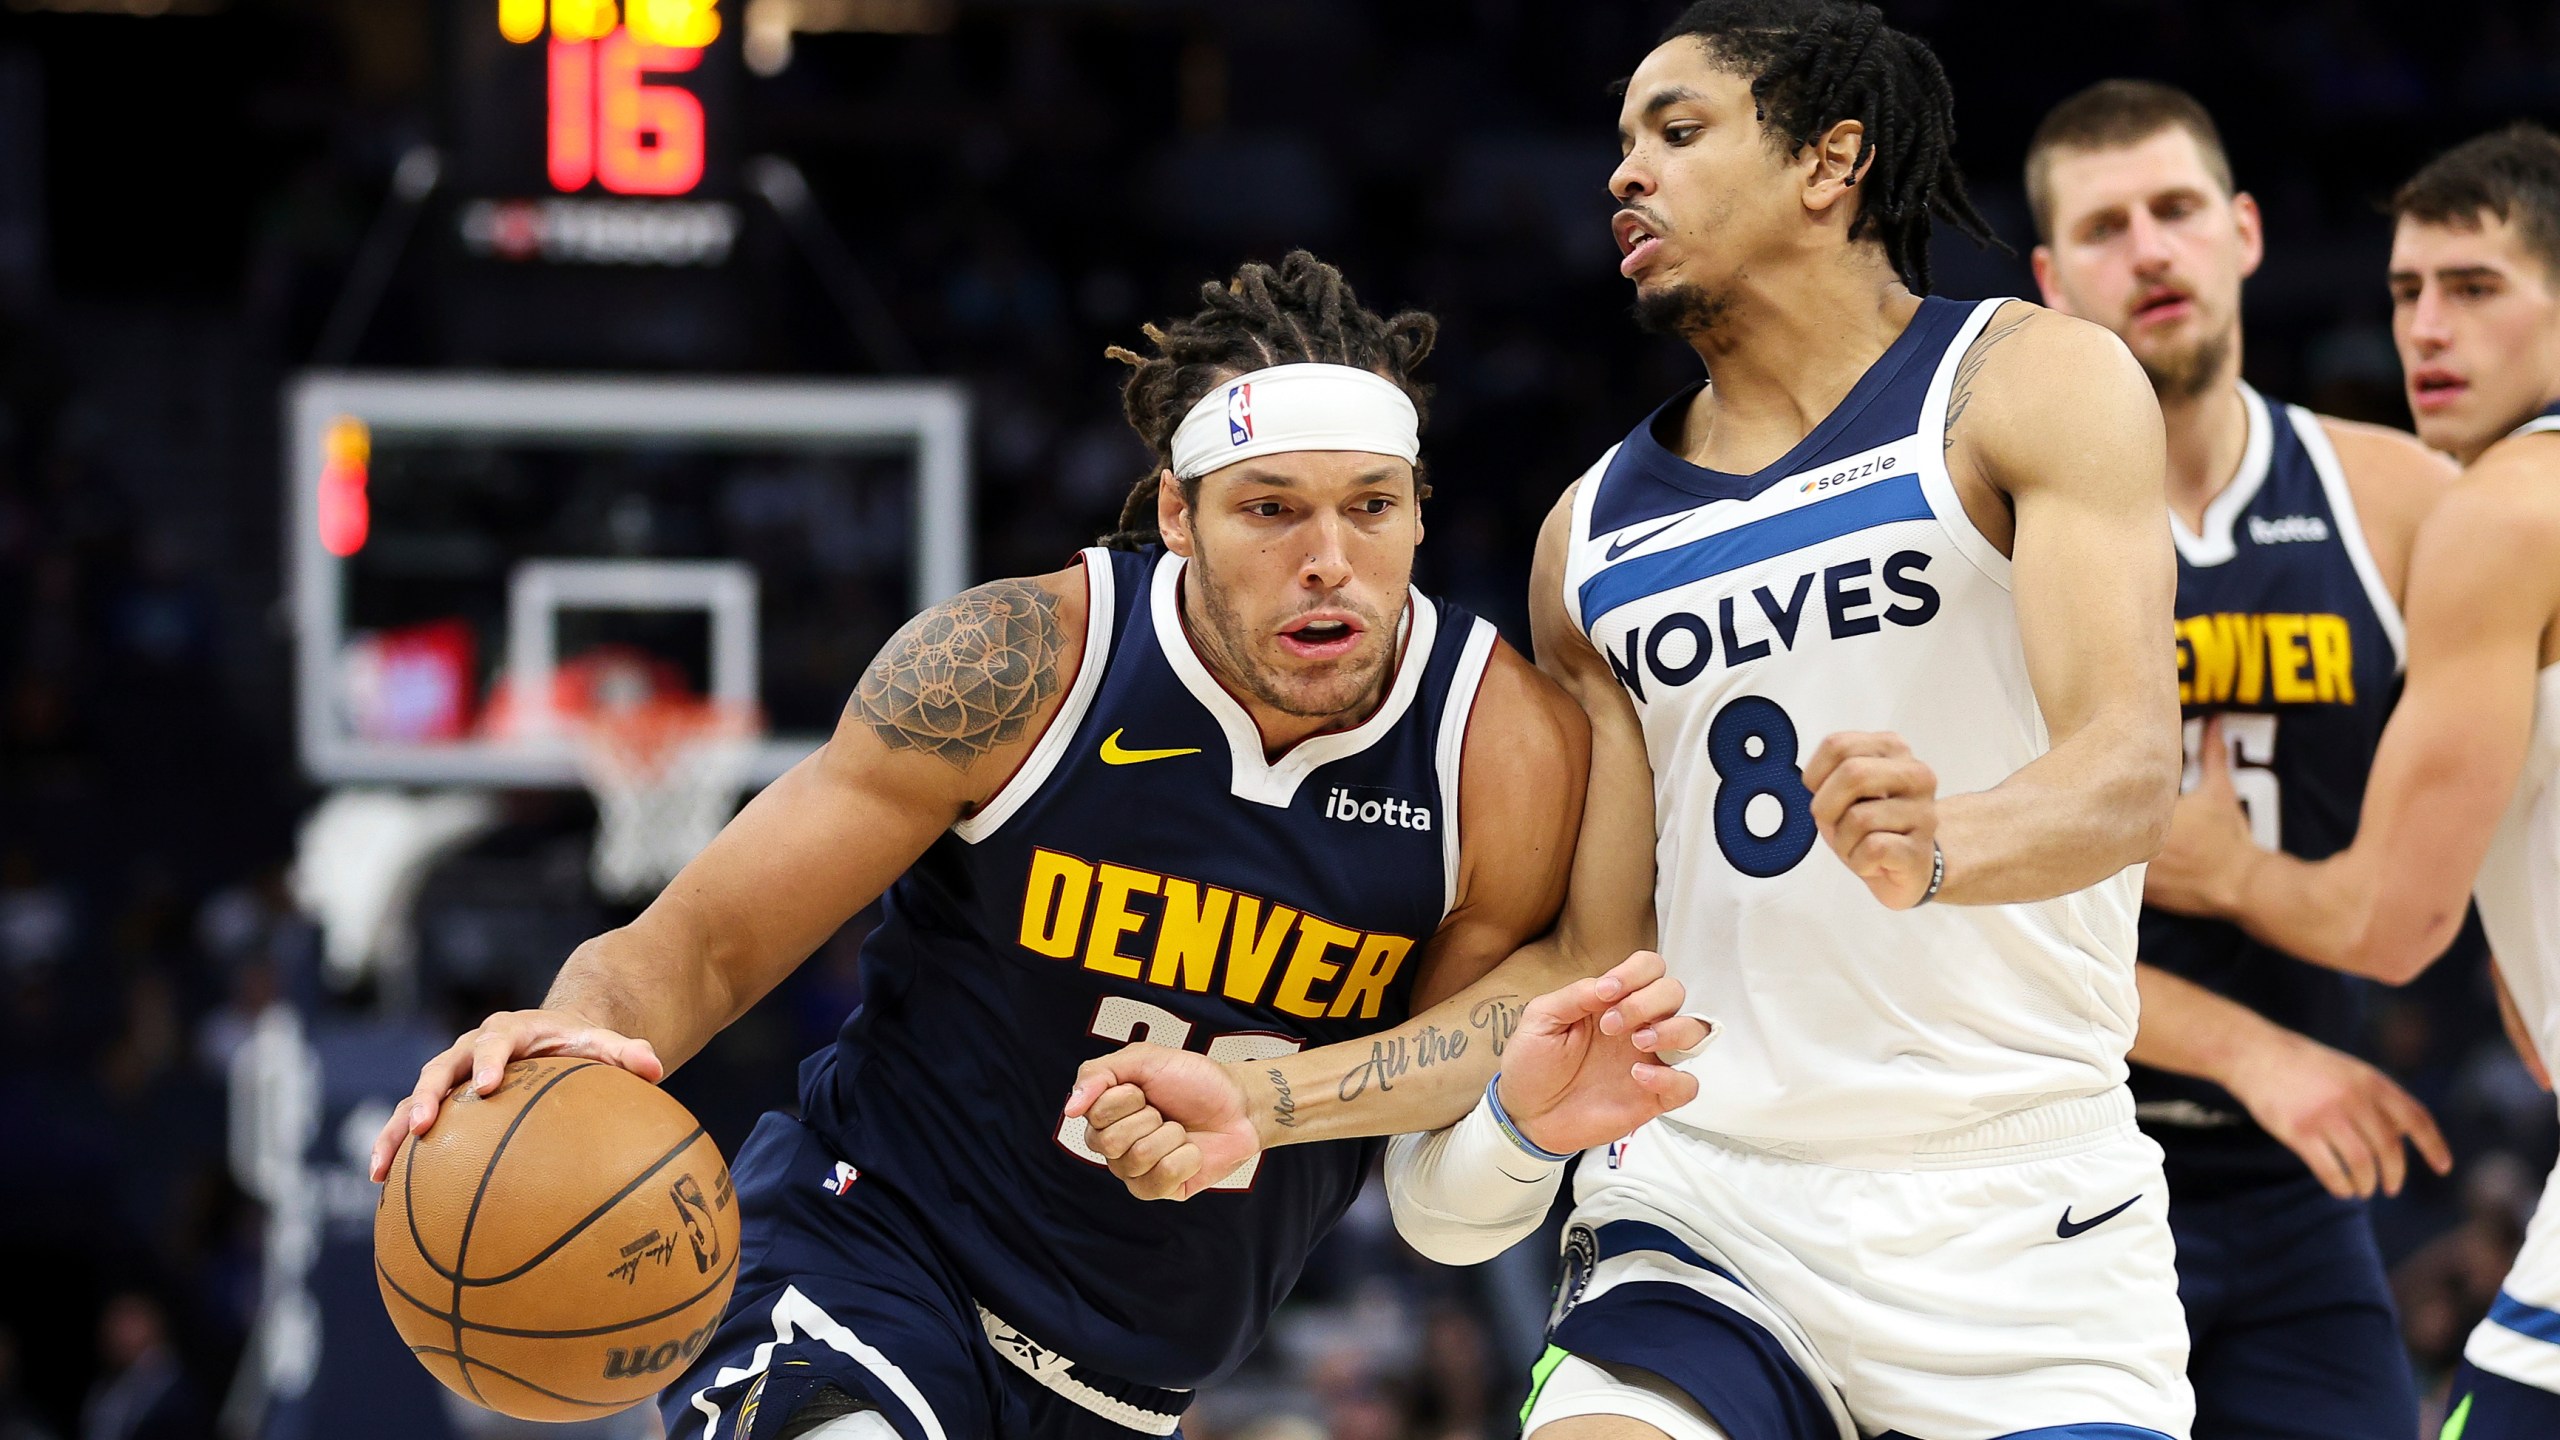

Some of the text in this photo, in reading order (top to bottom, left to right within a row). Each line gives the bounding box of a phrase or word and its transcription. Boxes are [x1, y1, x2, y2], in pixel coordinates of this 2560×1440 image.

[547, 24, 706, 195] 16
[1818, 456, 1896, 490] sezzle
[1325, 787, 1431, 831] ibotta
[1707, 695, 1819, 878] 8
[1015, 845, 1418, 1020] DENVER
[1266, 1068, 1297, 1127] Moses
[1338, 1036, 1410, 1101] All
[1412, 1025, 1469, 1068] the
